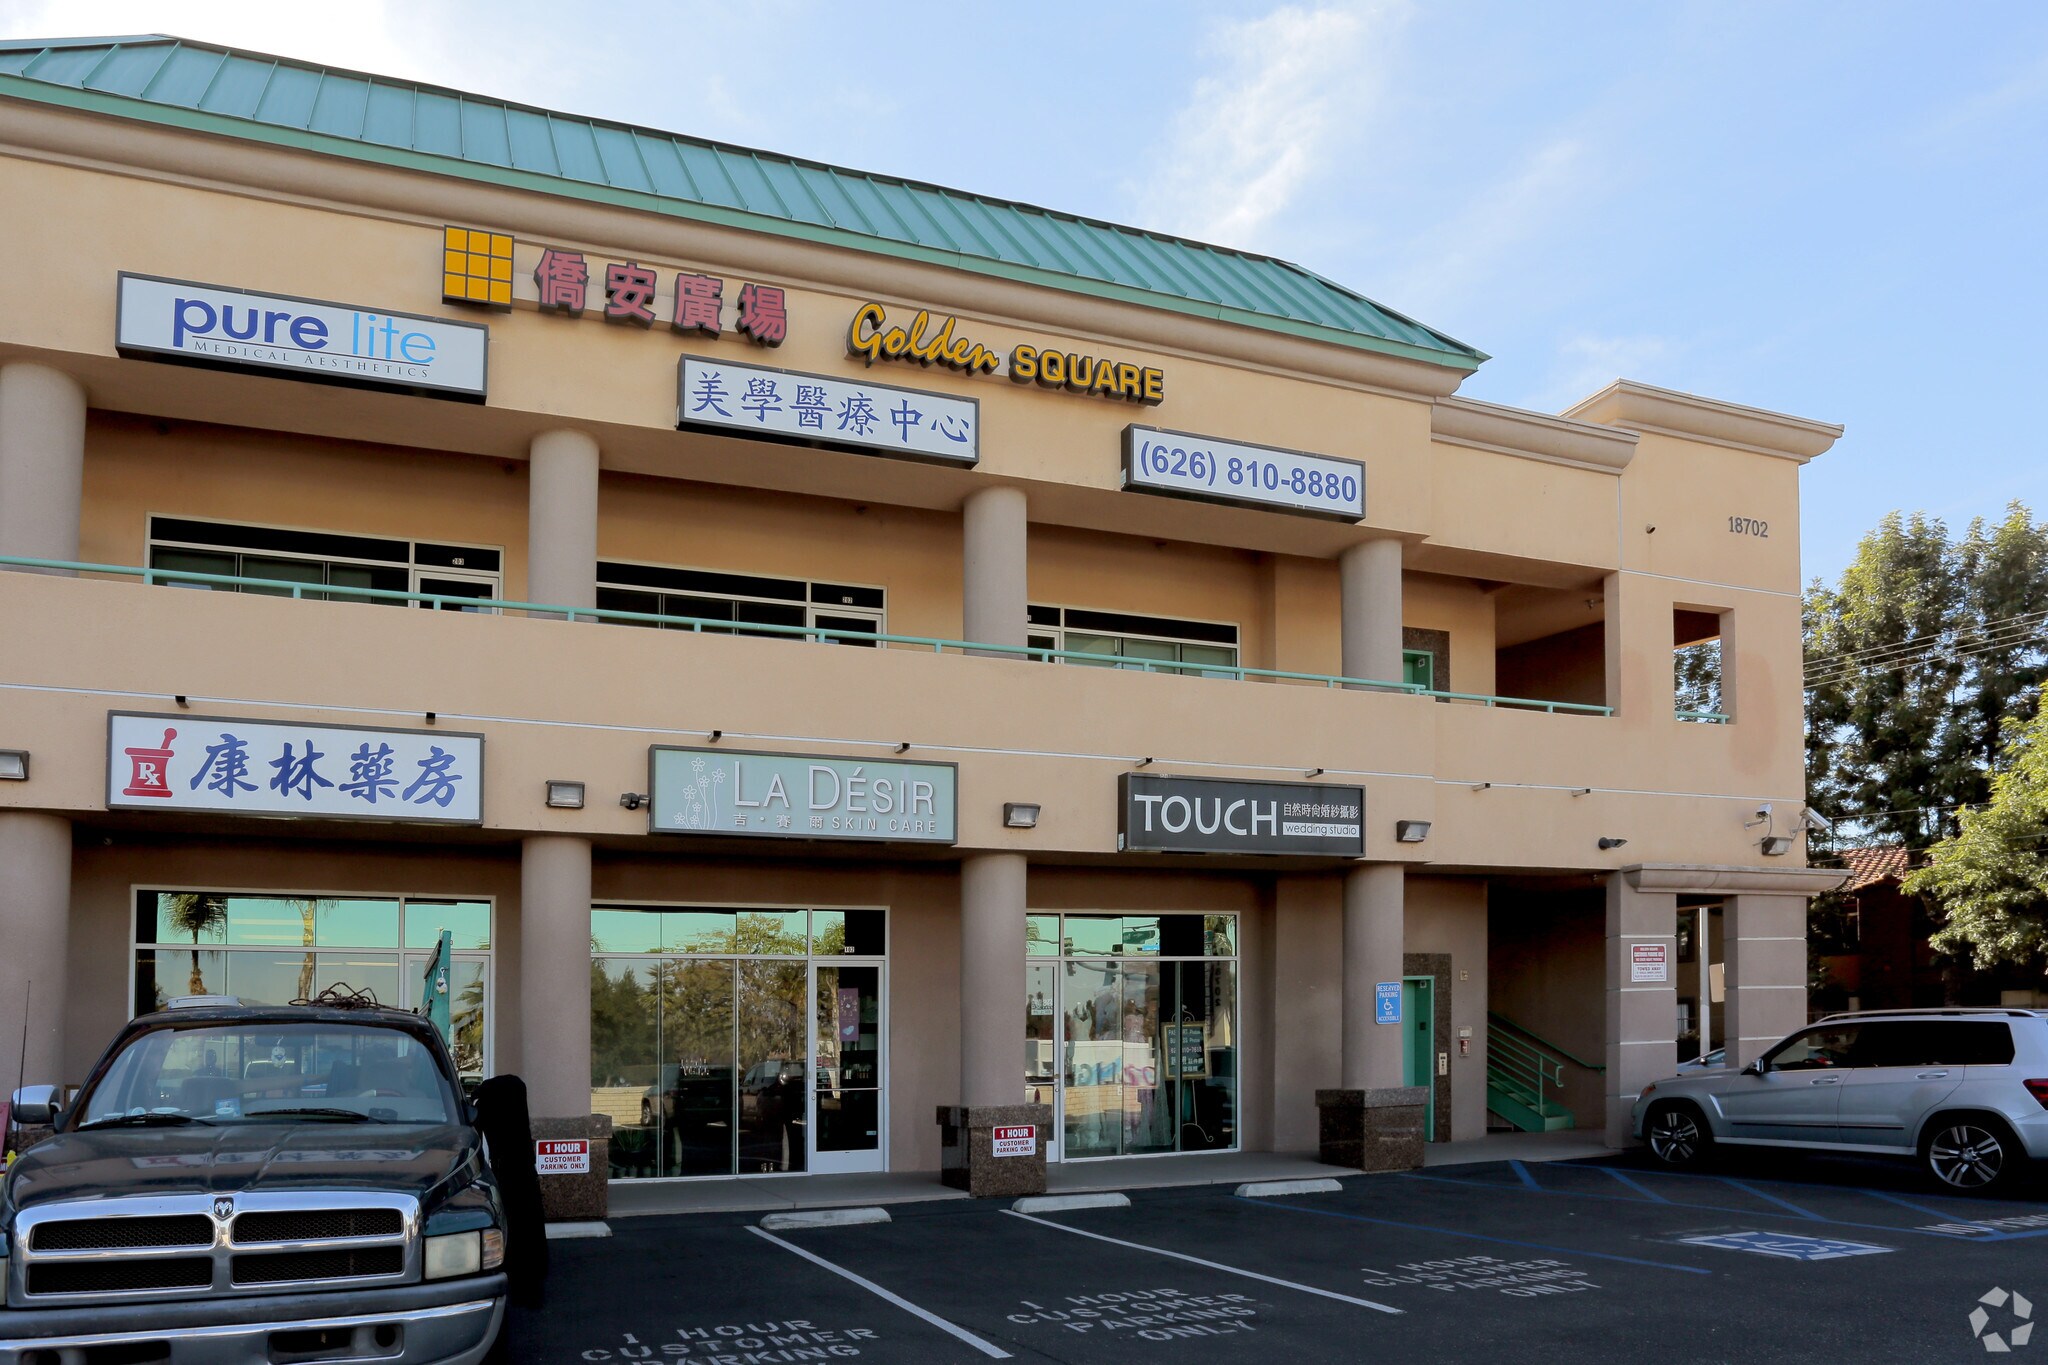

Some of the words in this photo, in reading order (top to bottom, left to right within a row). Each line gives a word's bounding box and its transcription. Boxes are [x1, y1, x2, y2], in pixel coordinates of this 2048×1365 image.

[533, 249, 787, 348] 僑安廣場
[172, 297, 329, 350] pure
[352, 312, 436, 364] lite
[194, 340, 289, 362] MEDICAL
[304, 354, 429, 378] AESTHETICS
[846, 302, 1001, 374] Golden
[1010, 344, 1164, 406] SQUARE
[691, 371, 970, 443] 美學醫療中心
[1140, 440, 1217, 487] (626)
[1227, 457, 1357, 503] 810-8880
[1728, 516, 1769, 538] 18702
[189, 733, 463, 808] 康林藥房
[733, 761, 791, 809] LA
[808, 764, 935, 816] DÉSIR
[832, 816, 877, 831] SKIN
[889, 818, 936, 834] CARE
[1134, 793, 1278, 836] TOUCH
[1283, 802, 1359, 819] 自然時尚婚紗攝影
[1285, 823, 1327, 837] wedding
[1329, 825, 1357, 836] studio
[1000, 1129, 1005, 1138] 1
[1007, 1128, 1029, 1138] HOUR
[544, 1155, 582, 1163] CUSTOMER
[545, 1143, 551, 1153] 1
[554, 1143, 581, 1153] HOUR
[1006, 1293, 1257, 1324] CUSTOMER
[1065, 1287, 1189, 1307] HOUR
[677, 1320, 818, 1340] HOUR
[1064, 1306, 1256, 1333] PARKING
[1137, 1319, 1256, 1341] ONLY
[581, 1328, 880, 1361] CUSTOMER
